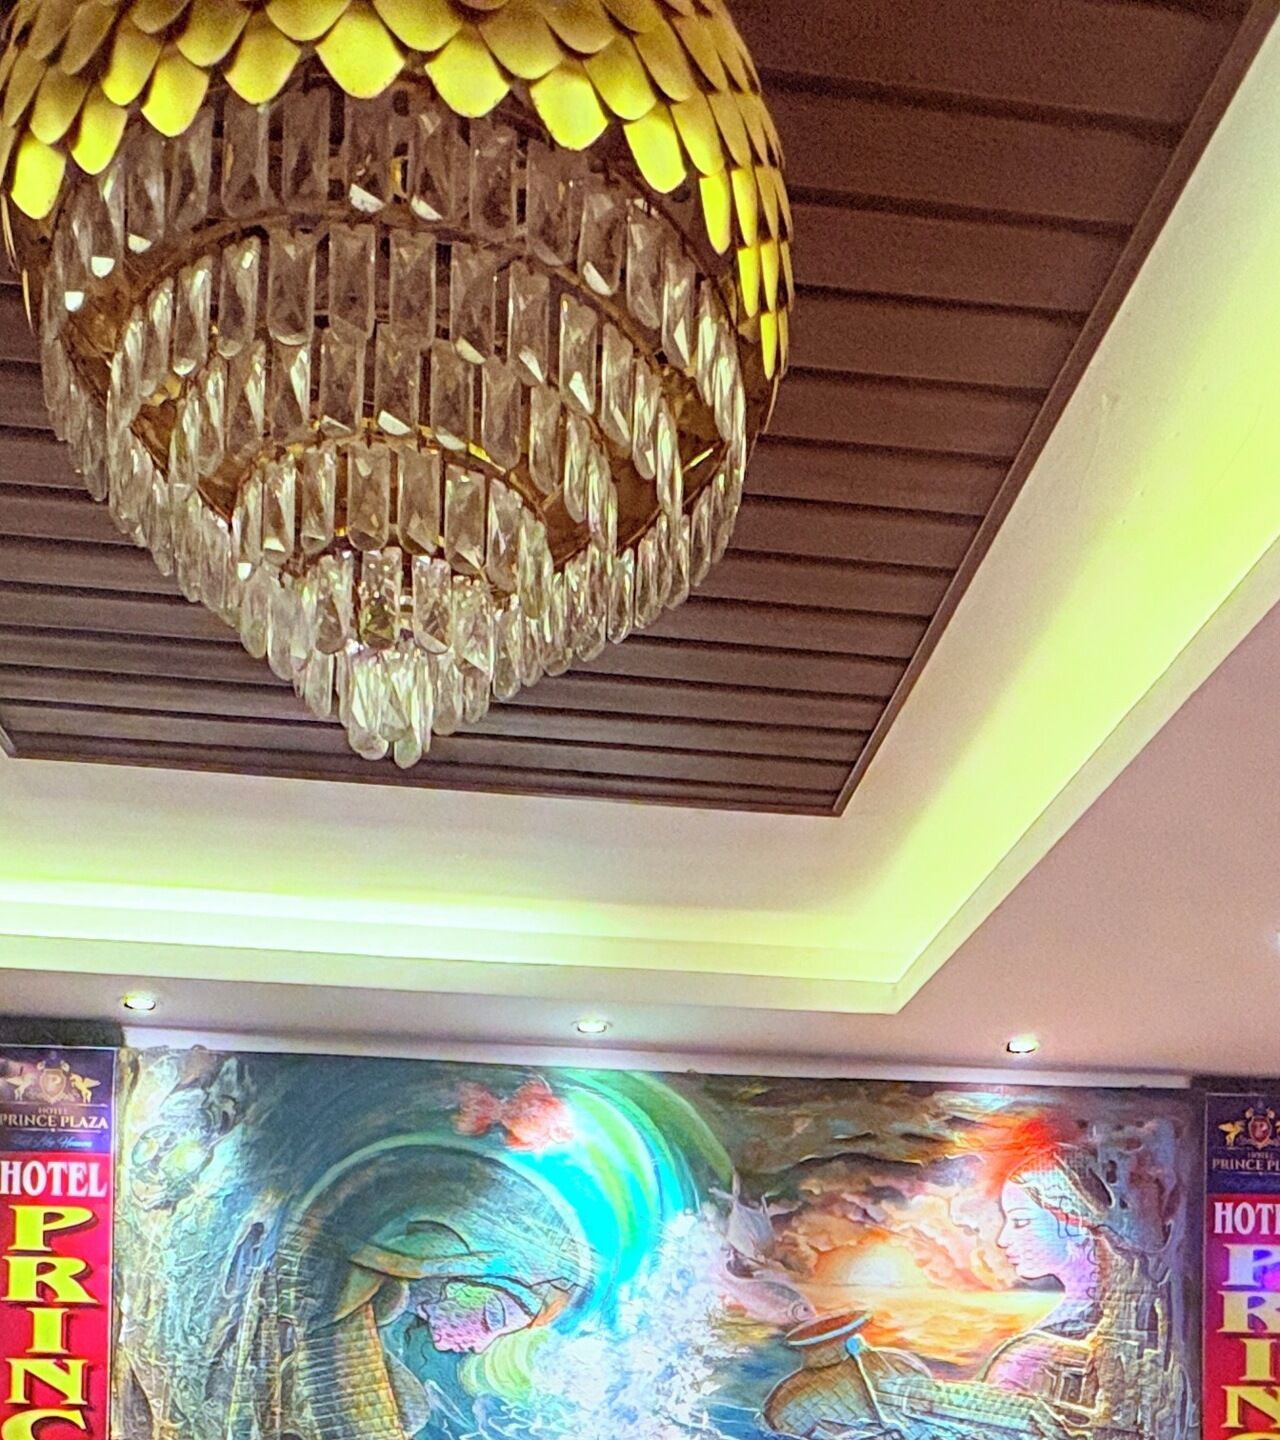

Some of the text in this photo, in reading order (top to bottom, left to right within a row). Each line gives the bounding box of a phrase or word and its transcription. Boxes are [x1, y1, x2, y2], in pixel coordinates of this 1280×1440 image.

[60, 1115, 109, 1130] PLAZA
[1212, 1158, 1264, 1171] PRINCE
[0, 1160, 108, 1198] HOTEL
